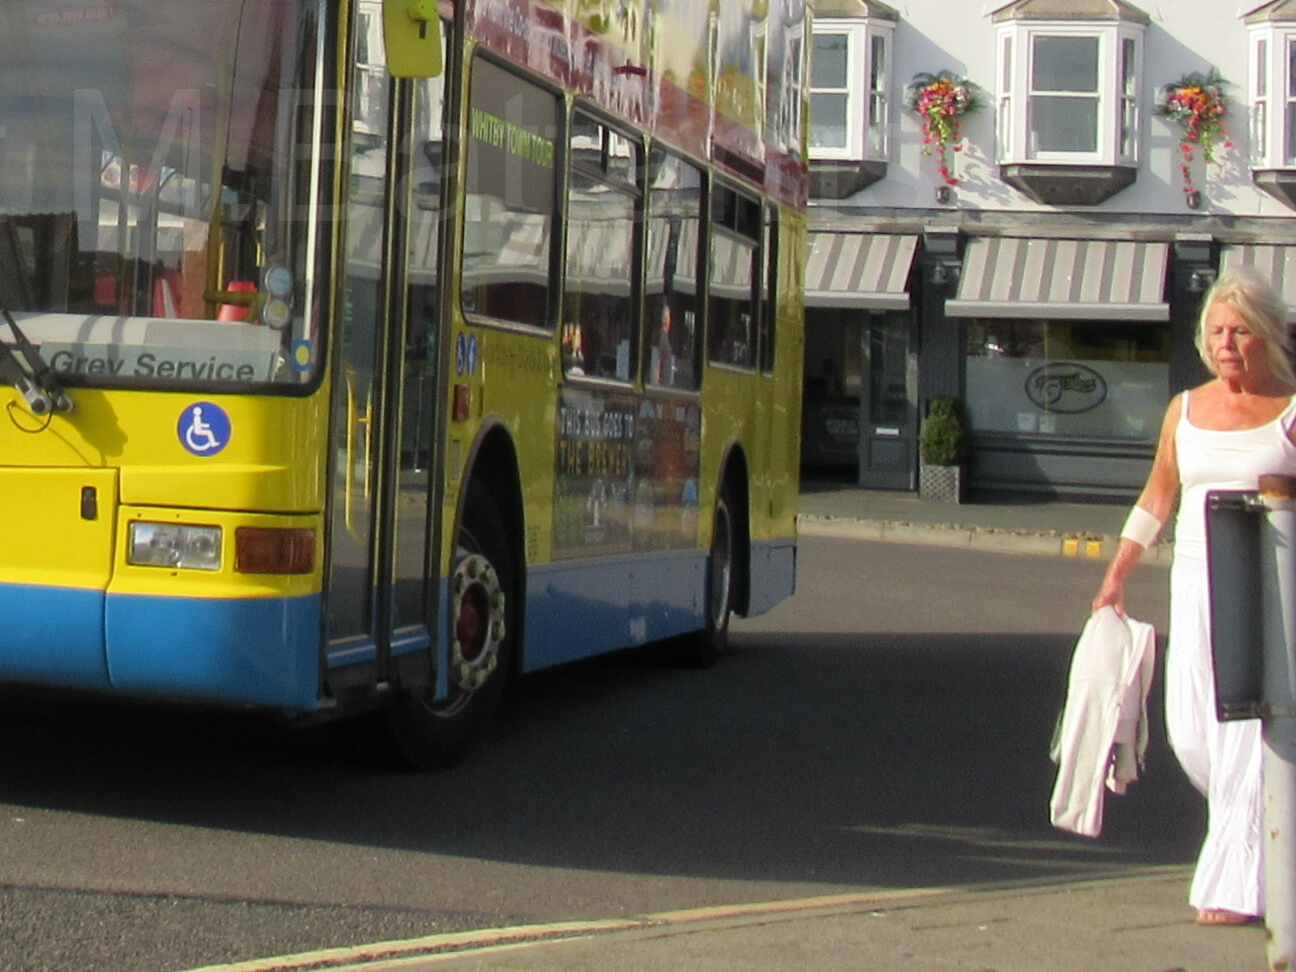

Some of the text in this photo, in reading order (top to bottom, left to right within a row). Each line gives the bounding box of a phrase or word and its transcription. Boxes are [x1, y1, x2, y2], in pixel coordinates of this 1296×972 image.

[472, 108, 505, 148] WHITBY
[505, 121, 531, 160] TOWN
[134, 352, 255, 380] Service
